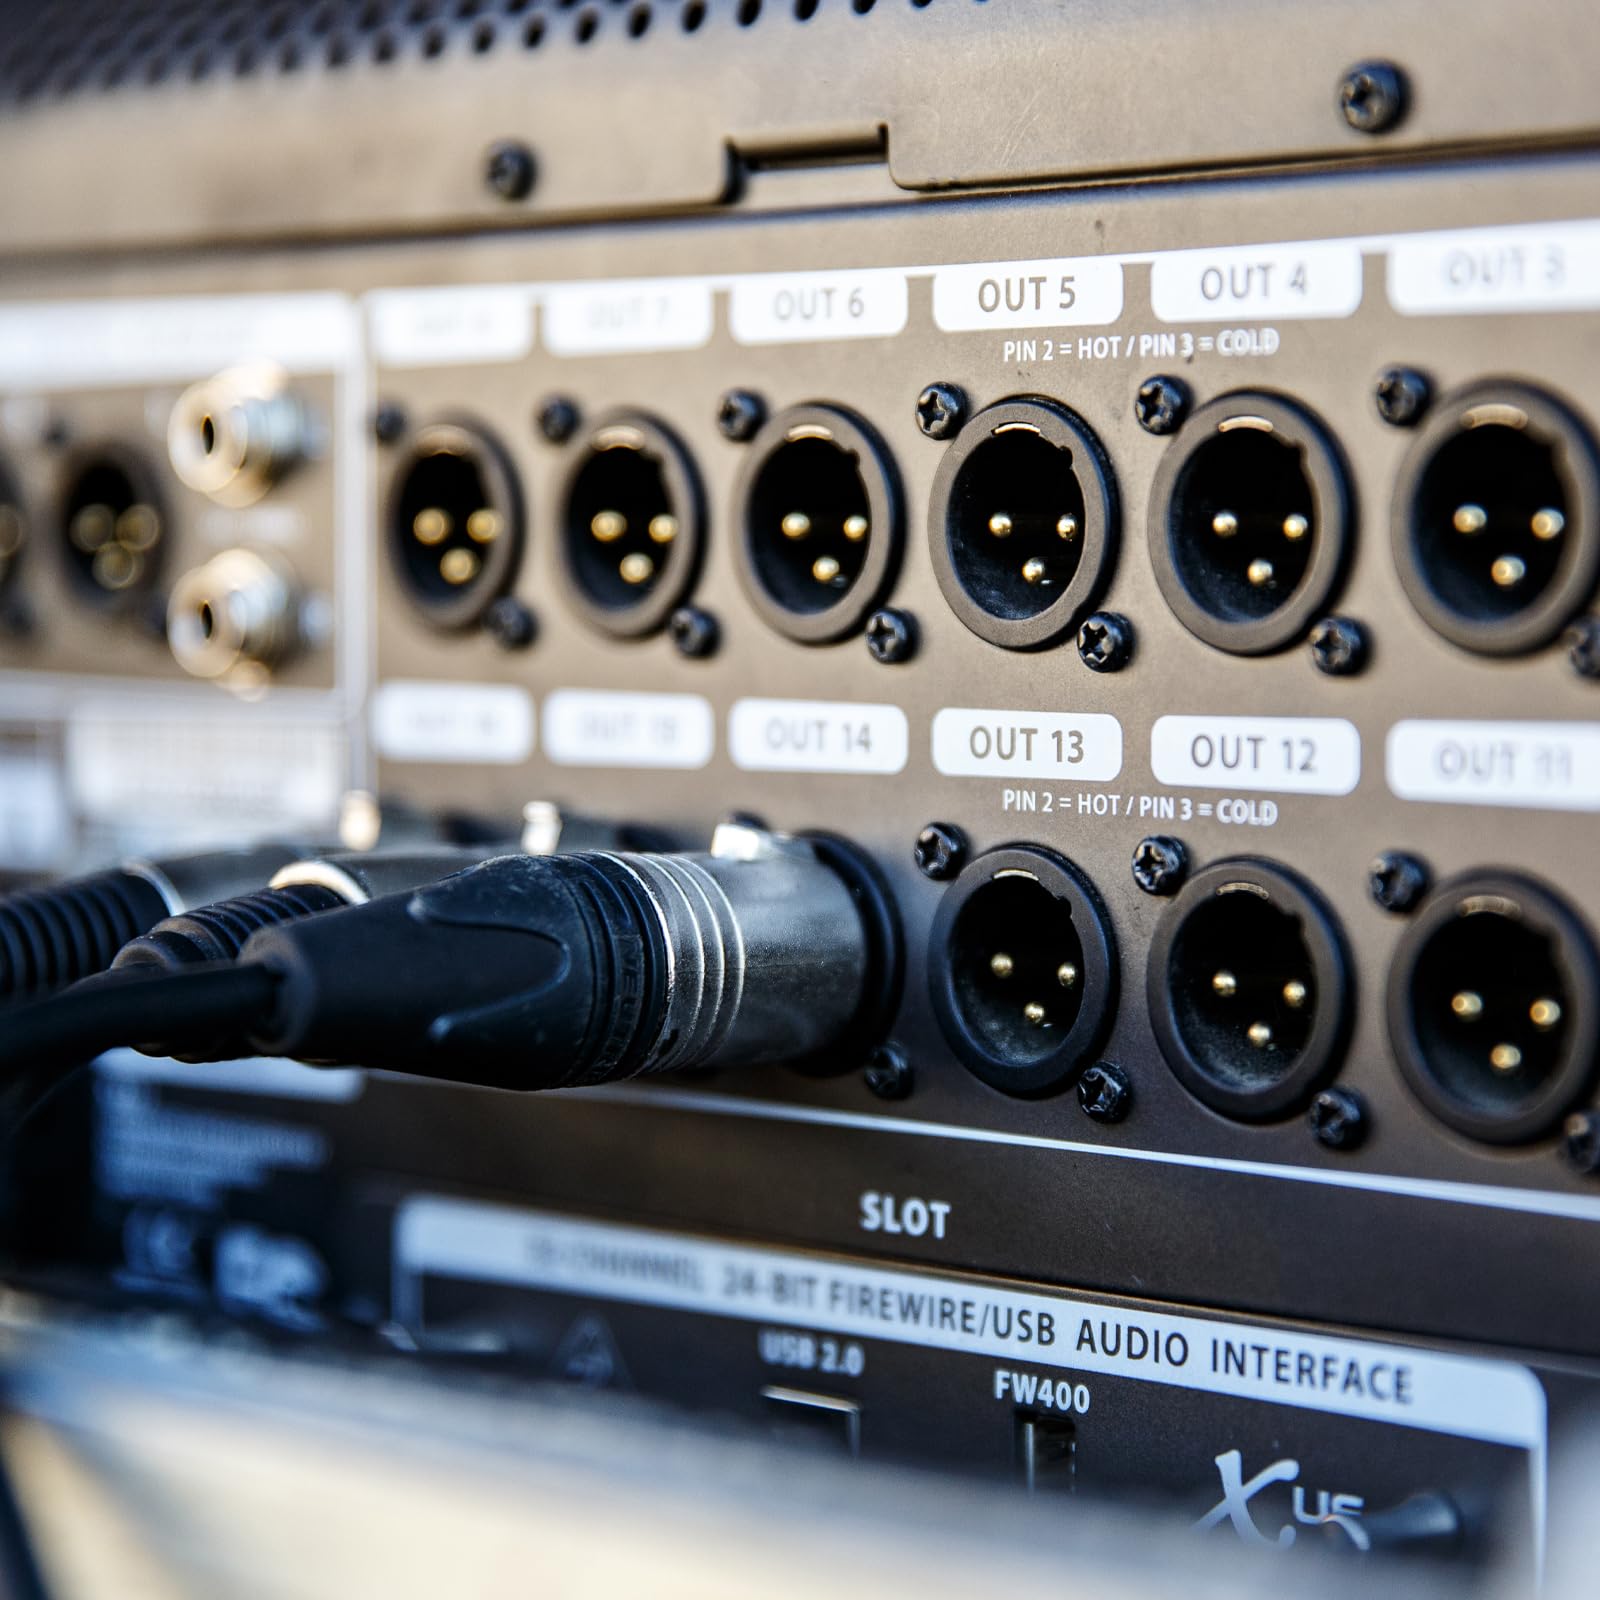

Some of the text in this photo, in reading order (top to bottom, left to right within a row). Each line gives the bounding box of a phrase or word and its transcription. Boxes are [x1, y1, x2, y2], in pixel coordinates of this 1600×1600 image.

[978, 275, 1076, 313] OUT 5
[1201, 261, 1306, 300] OUT 4
[773, 287, 865, 321] OUT 6
[1003, 340, 1037, 362] PIN
[1043, 340, 1053, 361] 2
[1078, 336, 1121, 360] HOT
[1139, 333, 1176, 358] PIN
[1180, 333, 1194, 357] 3
[1216, 328, 1280, 356] COLD
[766, 718, 873, 752] OUT 14
[969, 725, 1085, 763] OUT 13
[1191, 734, 1317, 772] OUT 12
[1003, 789, 1036, 812] PIN
[1042, 792, 1053, 813] 2
[1078, 793, 1121, 816] HOT
[1140, 796, 1175, 819] PIN
[1180, 798, 1193, 821] 3
[1216, 799, 1279, 826] COLD
[860, 1191, 950, 1239] SLOT
[724, 1262, 818, 1308] 24-BIT
[828, 1280, 1055, 1346] FIREWIRE/USB
[1076, 1318, 1189, 1367] AUDIO
[1212, 1338, 1413, 1405] INTERFACE
[758, 1328, 865, 1378] USB 2.0
[994, 1370, 1091, 1415] FW400
